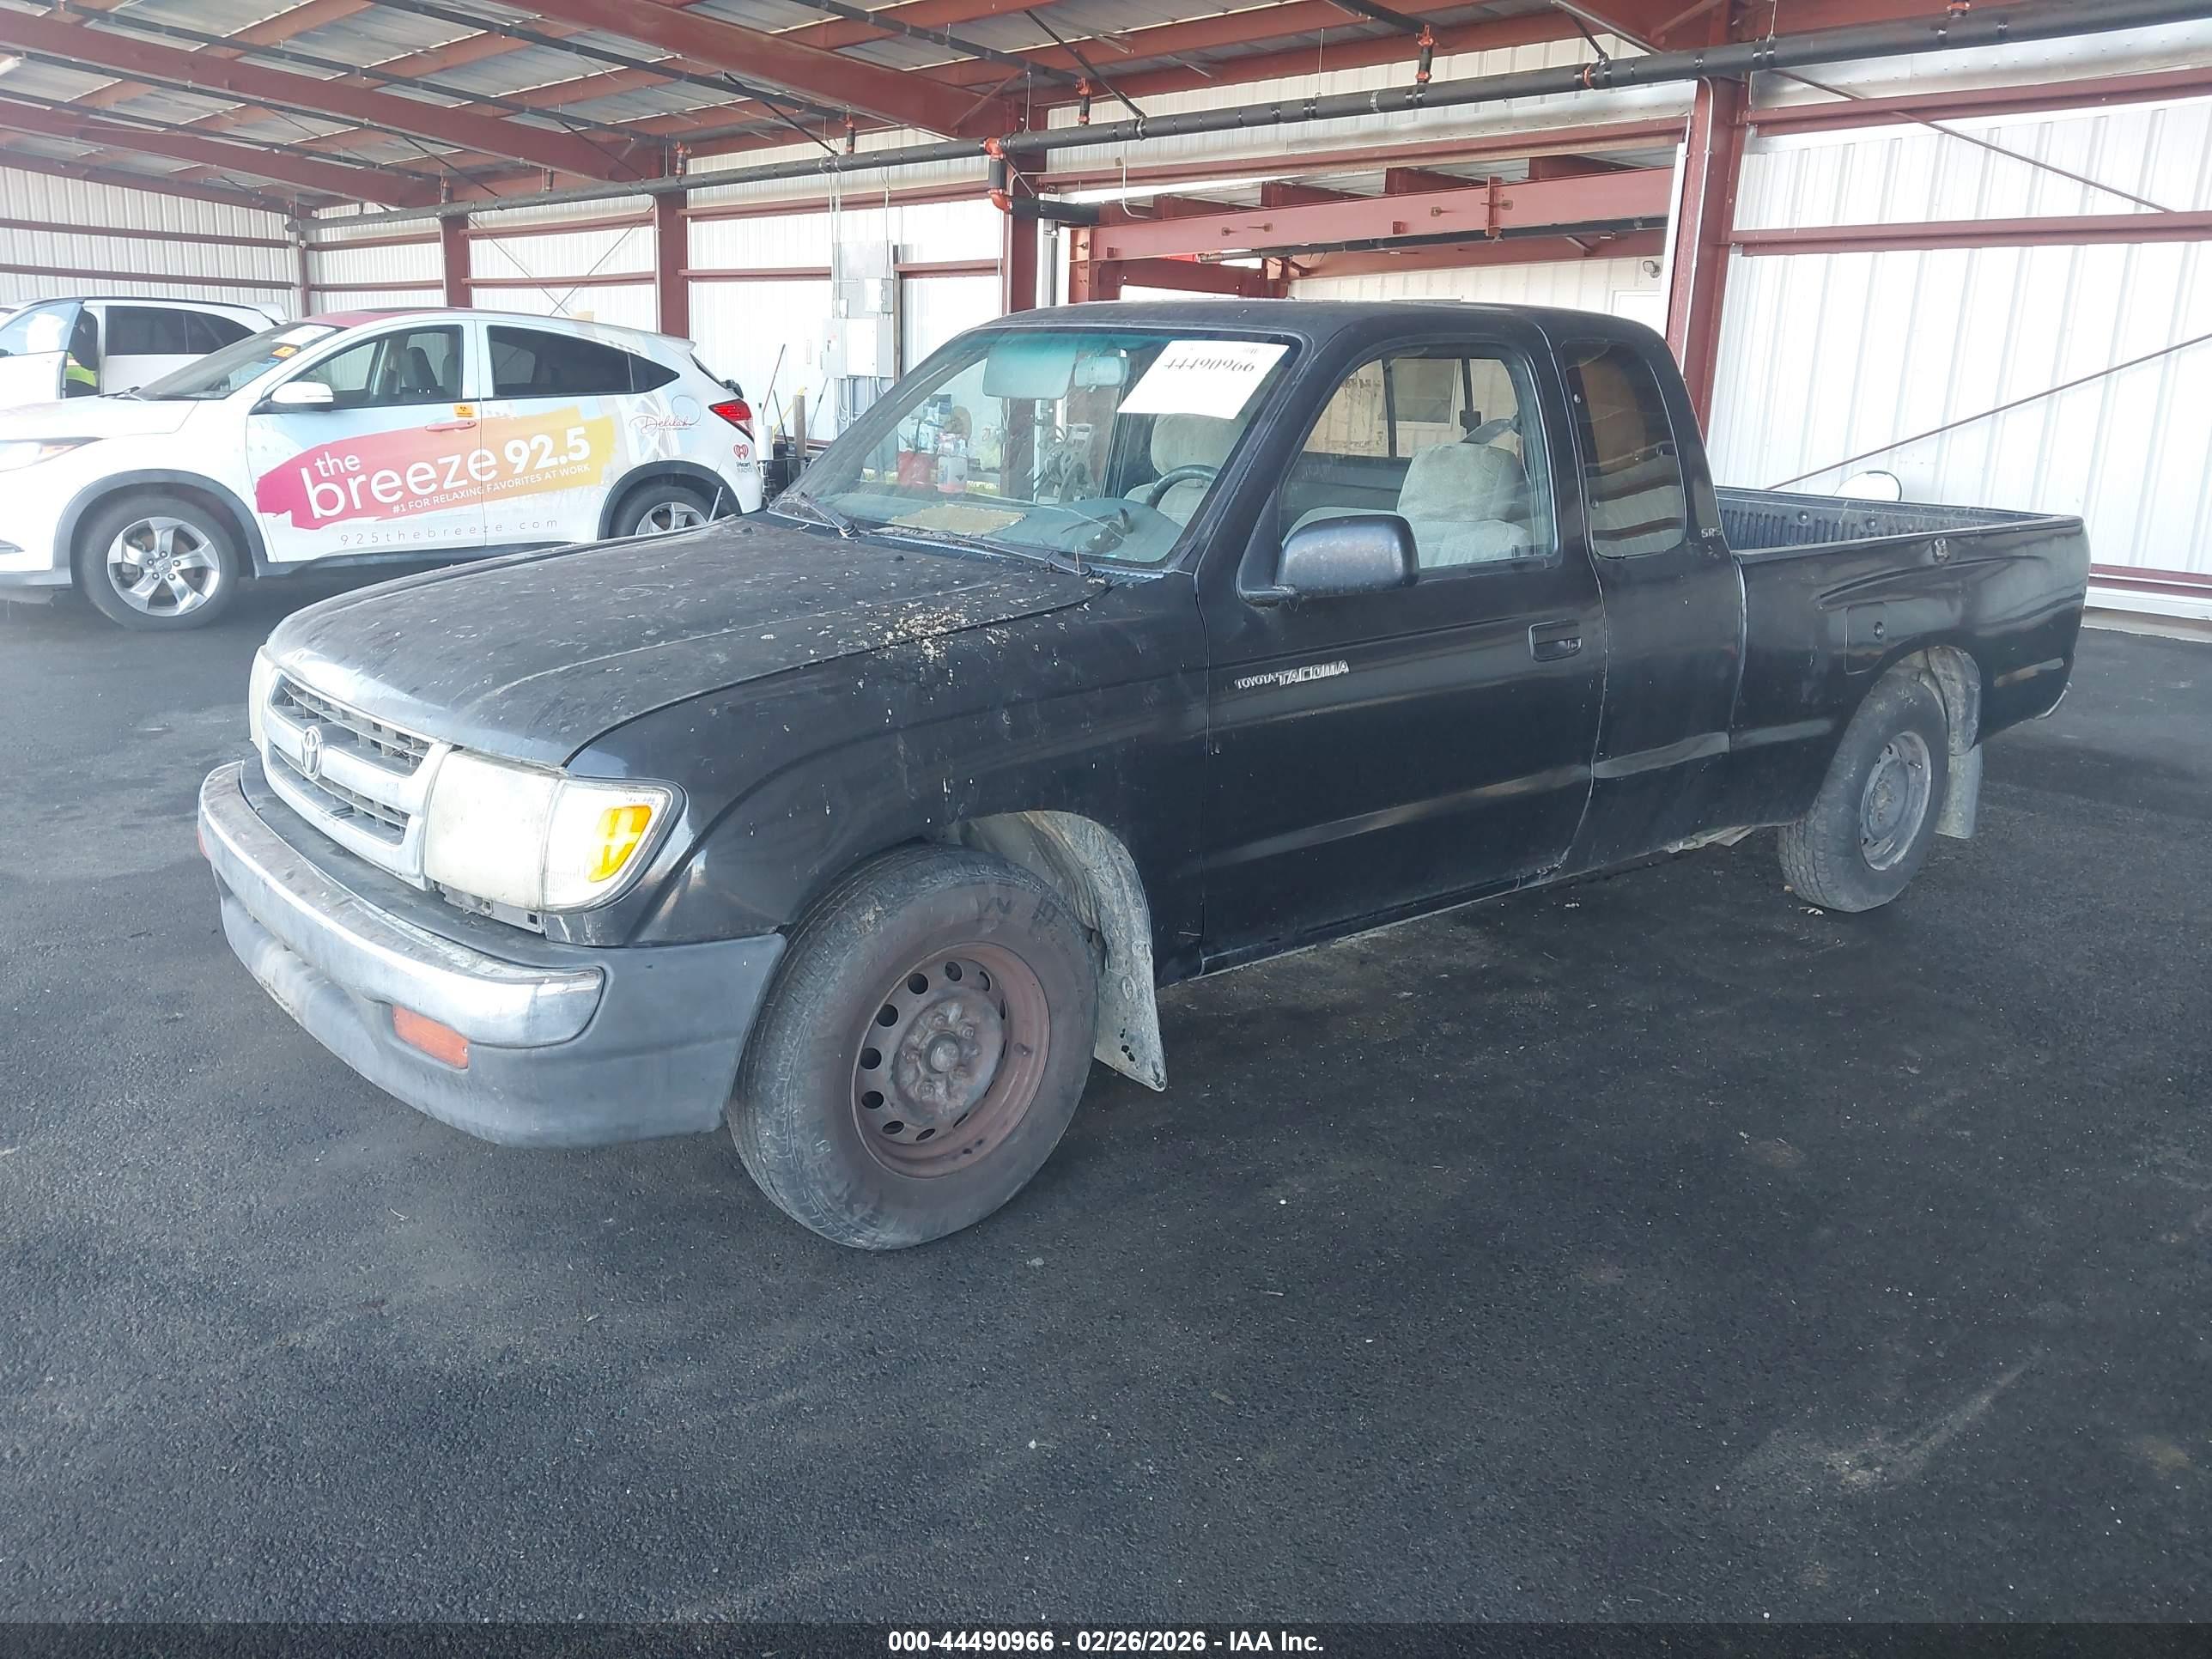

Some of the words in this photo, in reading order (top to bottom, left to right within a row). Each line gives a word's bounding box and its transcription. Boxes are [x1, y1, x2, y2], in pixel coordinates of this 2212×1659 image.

[1164, 357, 1255, 372] 44490966
[301, 448, 498, 519] breeze
[504, 426, 591, 475] 92.5
[314, 451, 362, 477] the
[392, 503, 407, 514] #1
[408, 498, 431, 510] FOR
[432, 486, 485, 506] RELAXING
[486, 473, 542, 493] FAVORITES
[544, 471, 557, 481] AT
[558, 464, 591, 477] WORK
[340, 519, 557, 545] 925thebreeze.com
[1277, 659, 1350, 687] TACOMA
